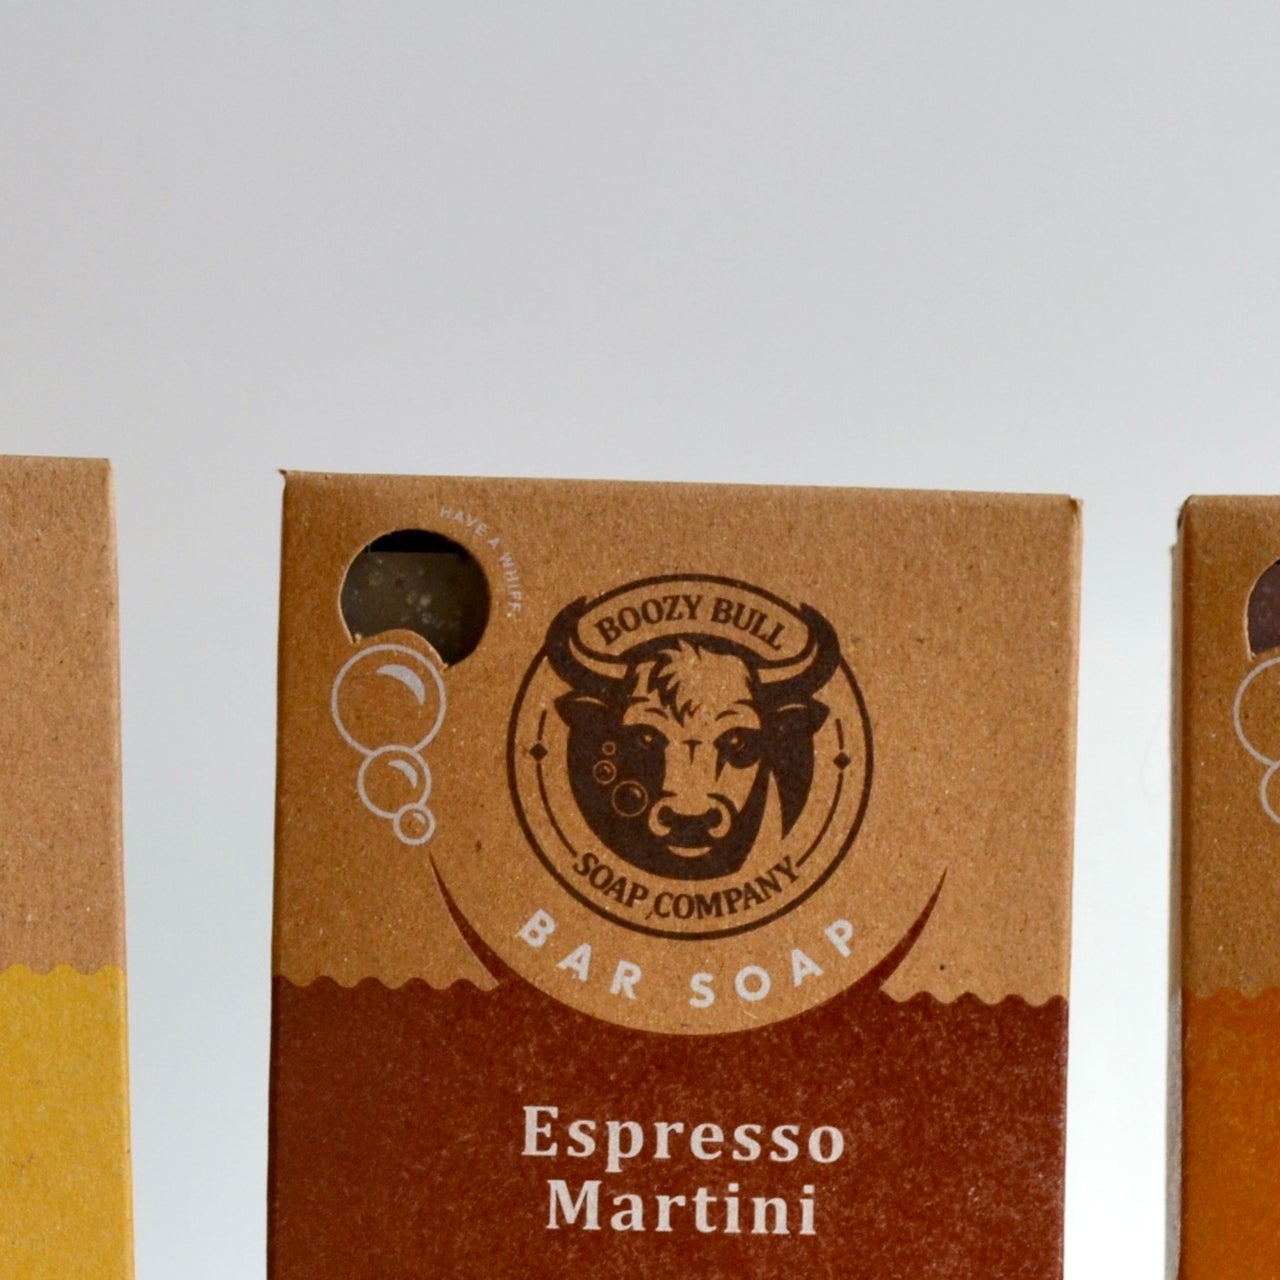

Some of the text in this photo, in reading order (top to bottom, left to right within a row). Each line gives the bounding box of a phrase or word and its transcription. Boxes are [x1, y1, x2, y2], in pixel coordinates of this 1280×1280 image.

[440, 505, 522, 612] HAVE A WHIFF
[593, 593, 786, 651] BOOZY BULL
[572, 851, 799, 920] SOAP COMPANY
[519, 908, 855, 1009] BAR SOAP
[522, 1105, 845, 1173] Espresso
[546, 1179, 817, 1235] Martini
